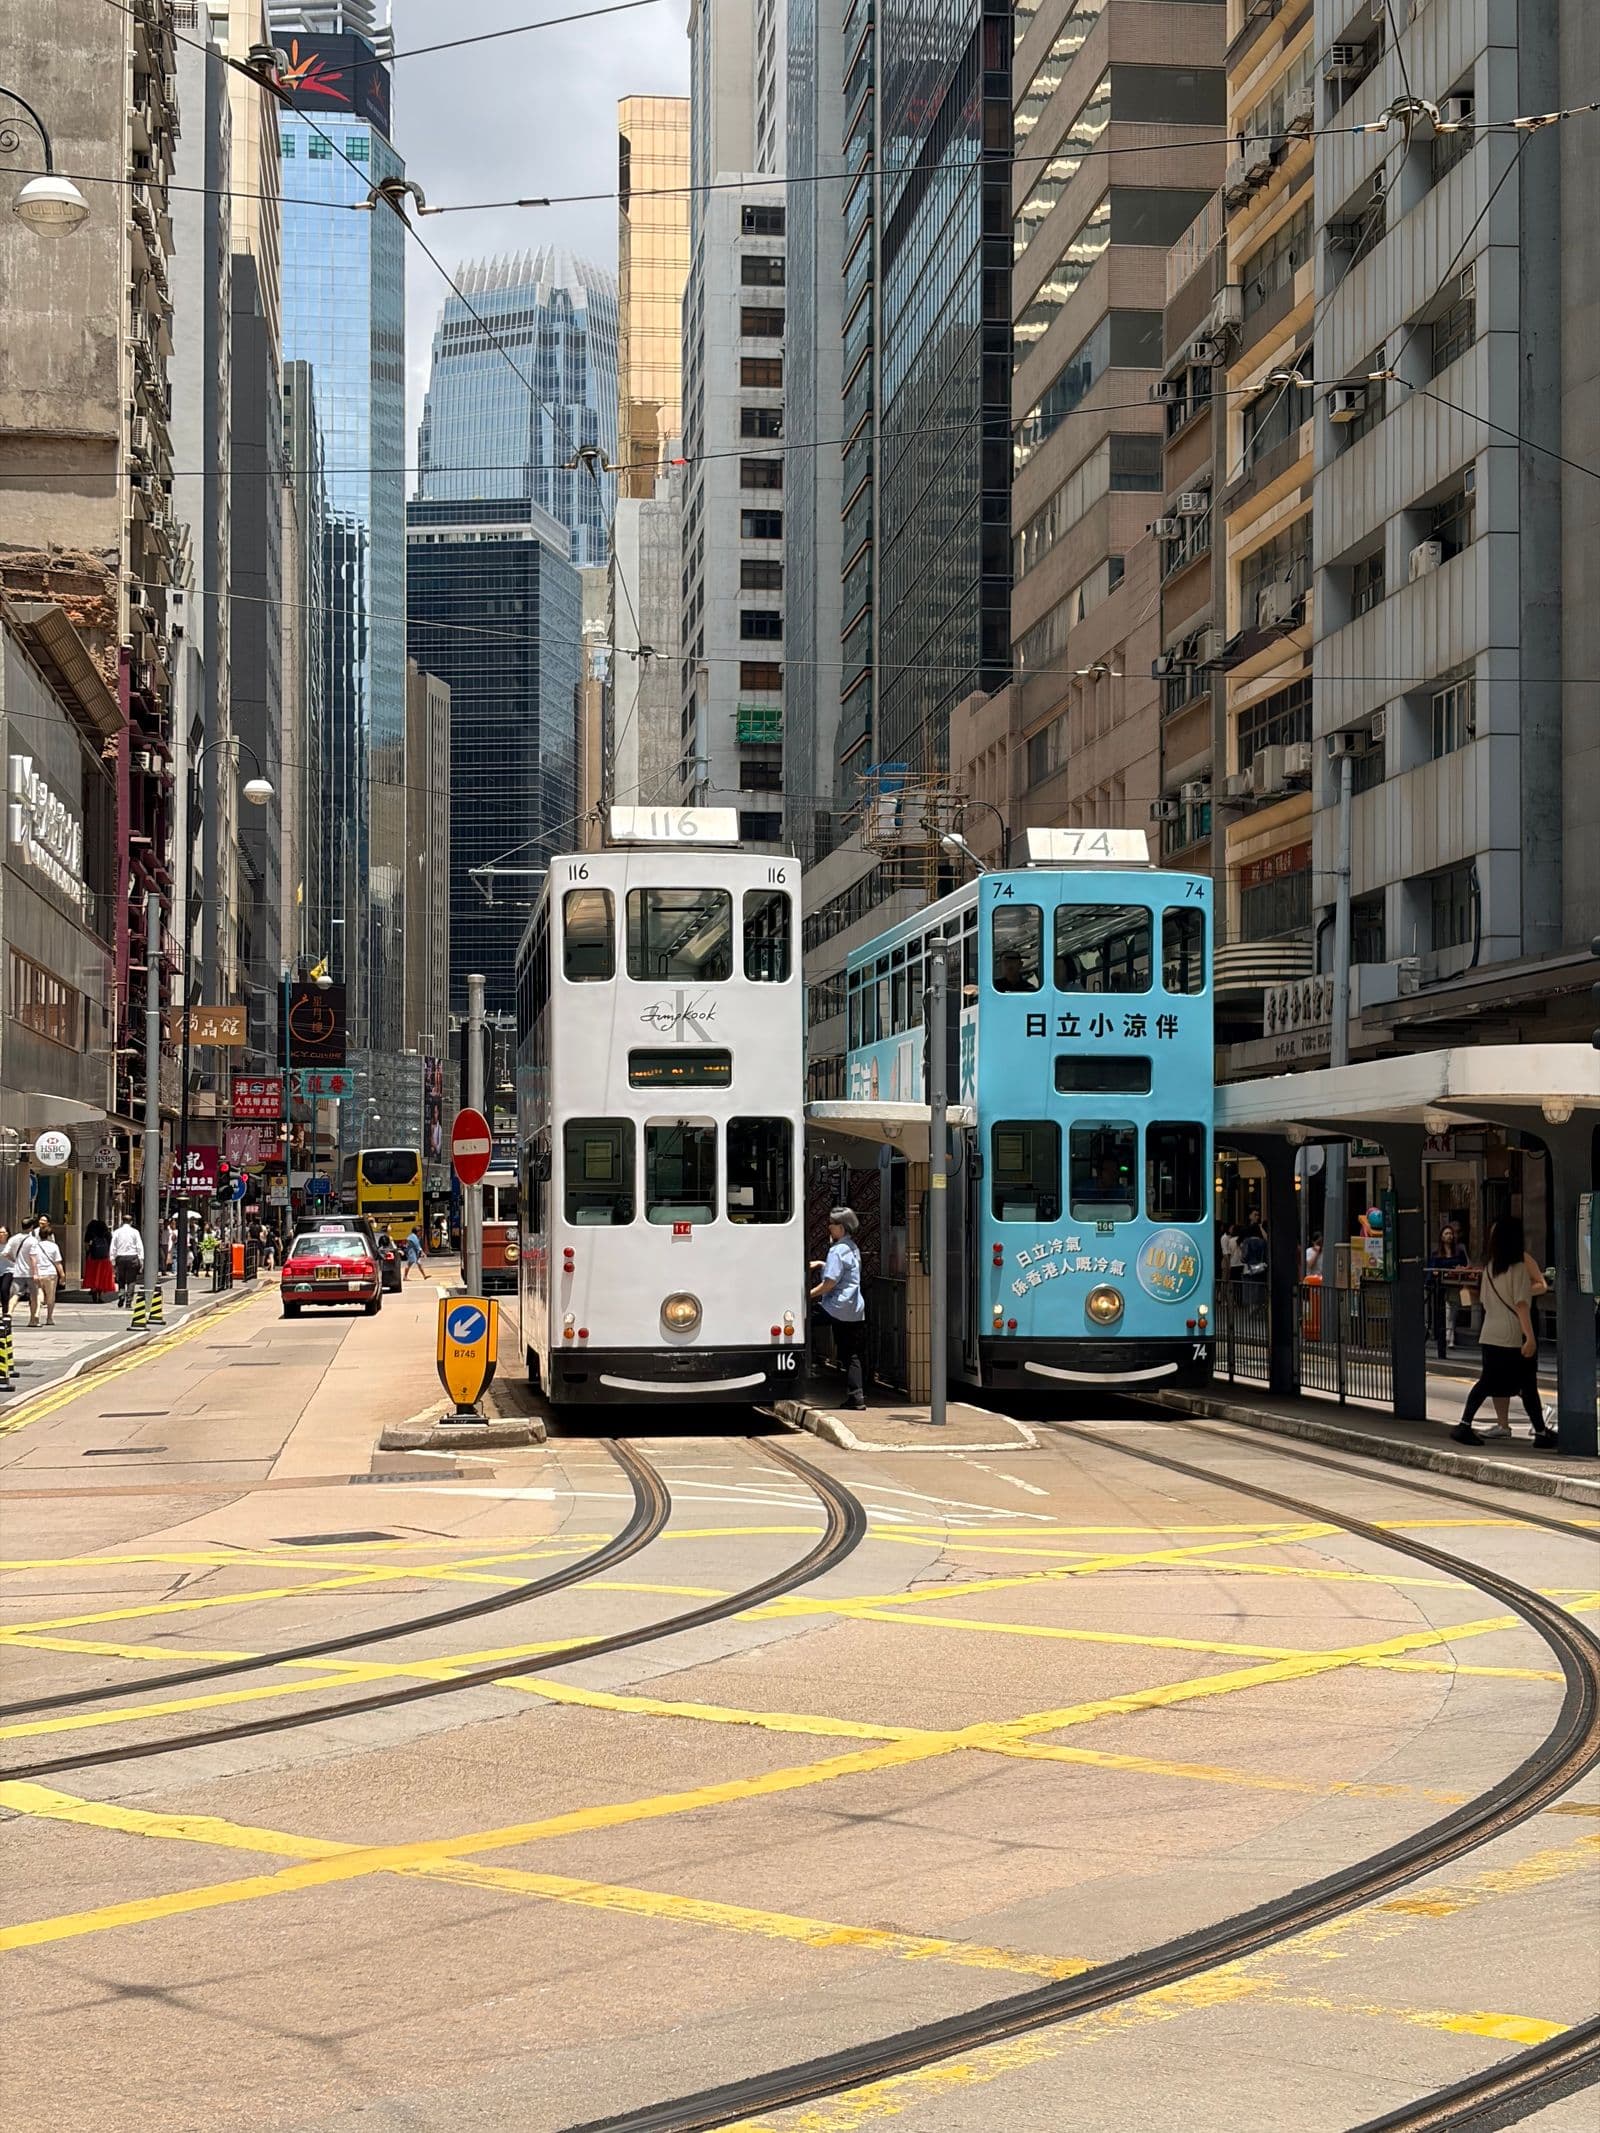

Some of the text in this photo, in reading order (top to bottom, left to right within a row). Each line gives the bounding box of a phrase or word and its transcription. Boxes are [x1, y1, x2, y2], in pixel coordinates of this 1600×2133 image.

[650, 810, 698, 837] 116
[1063, 831, 1110, 857] 74
[568, 863, 589, 881] 116
[768, 867, 786, 884] 116
[993, 882, 1014, 899] 74
[1185, 882, 1205, 899] 74
[1026, 1012, 1179, 1040] 日立小涼伴
[40, 1145, 65, 1153] HSBC
[675, 1224, 690, 1233] 114
[1015, 1236, 1082, 1269] 日立冷氣
[1011, 1256, 1127, 1297] 係香港人嘅冷氣
[453, 1349, 476, 1358] B745
[777, 1352, 796, 1370] 116
[1192, 1343, 1207, 1361] 74
